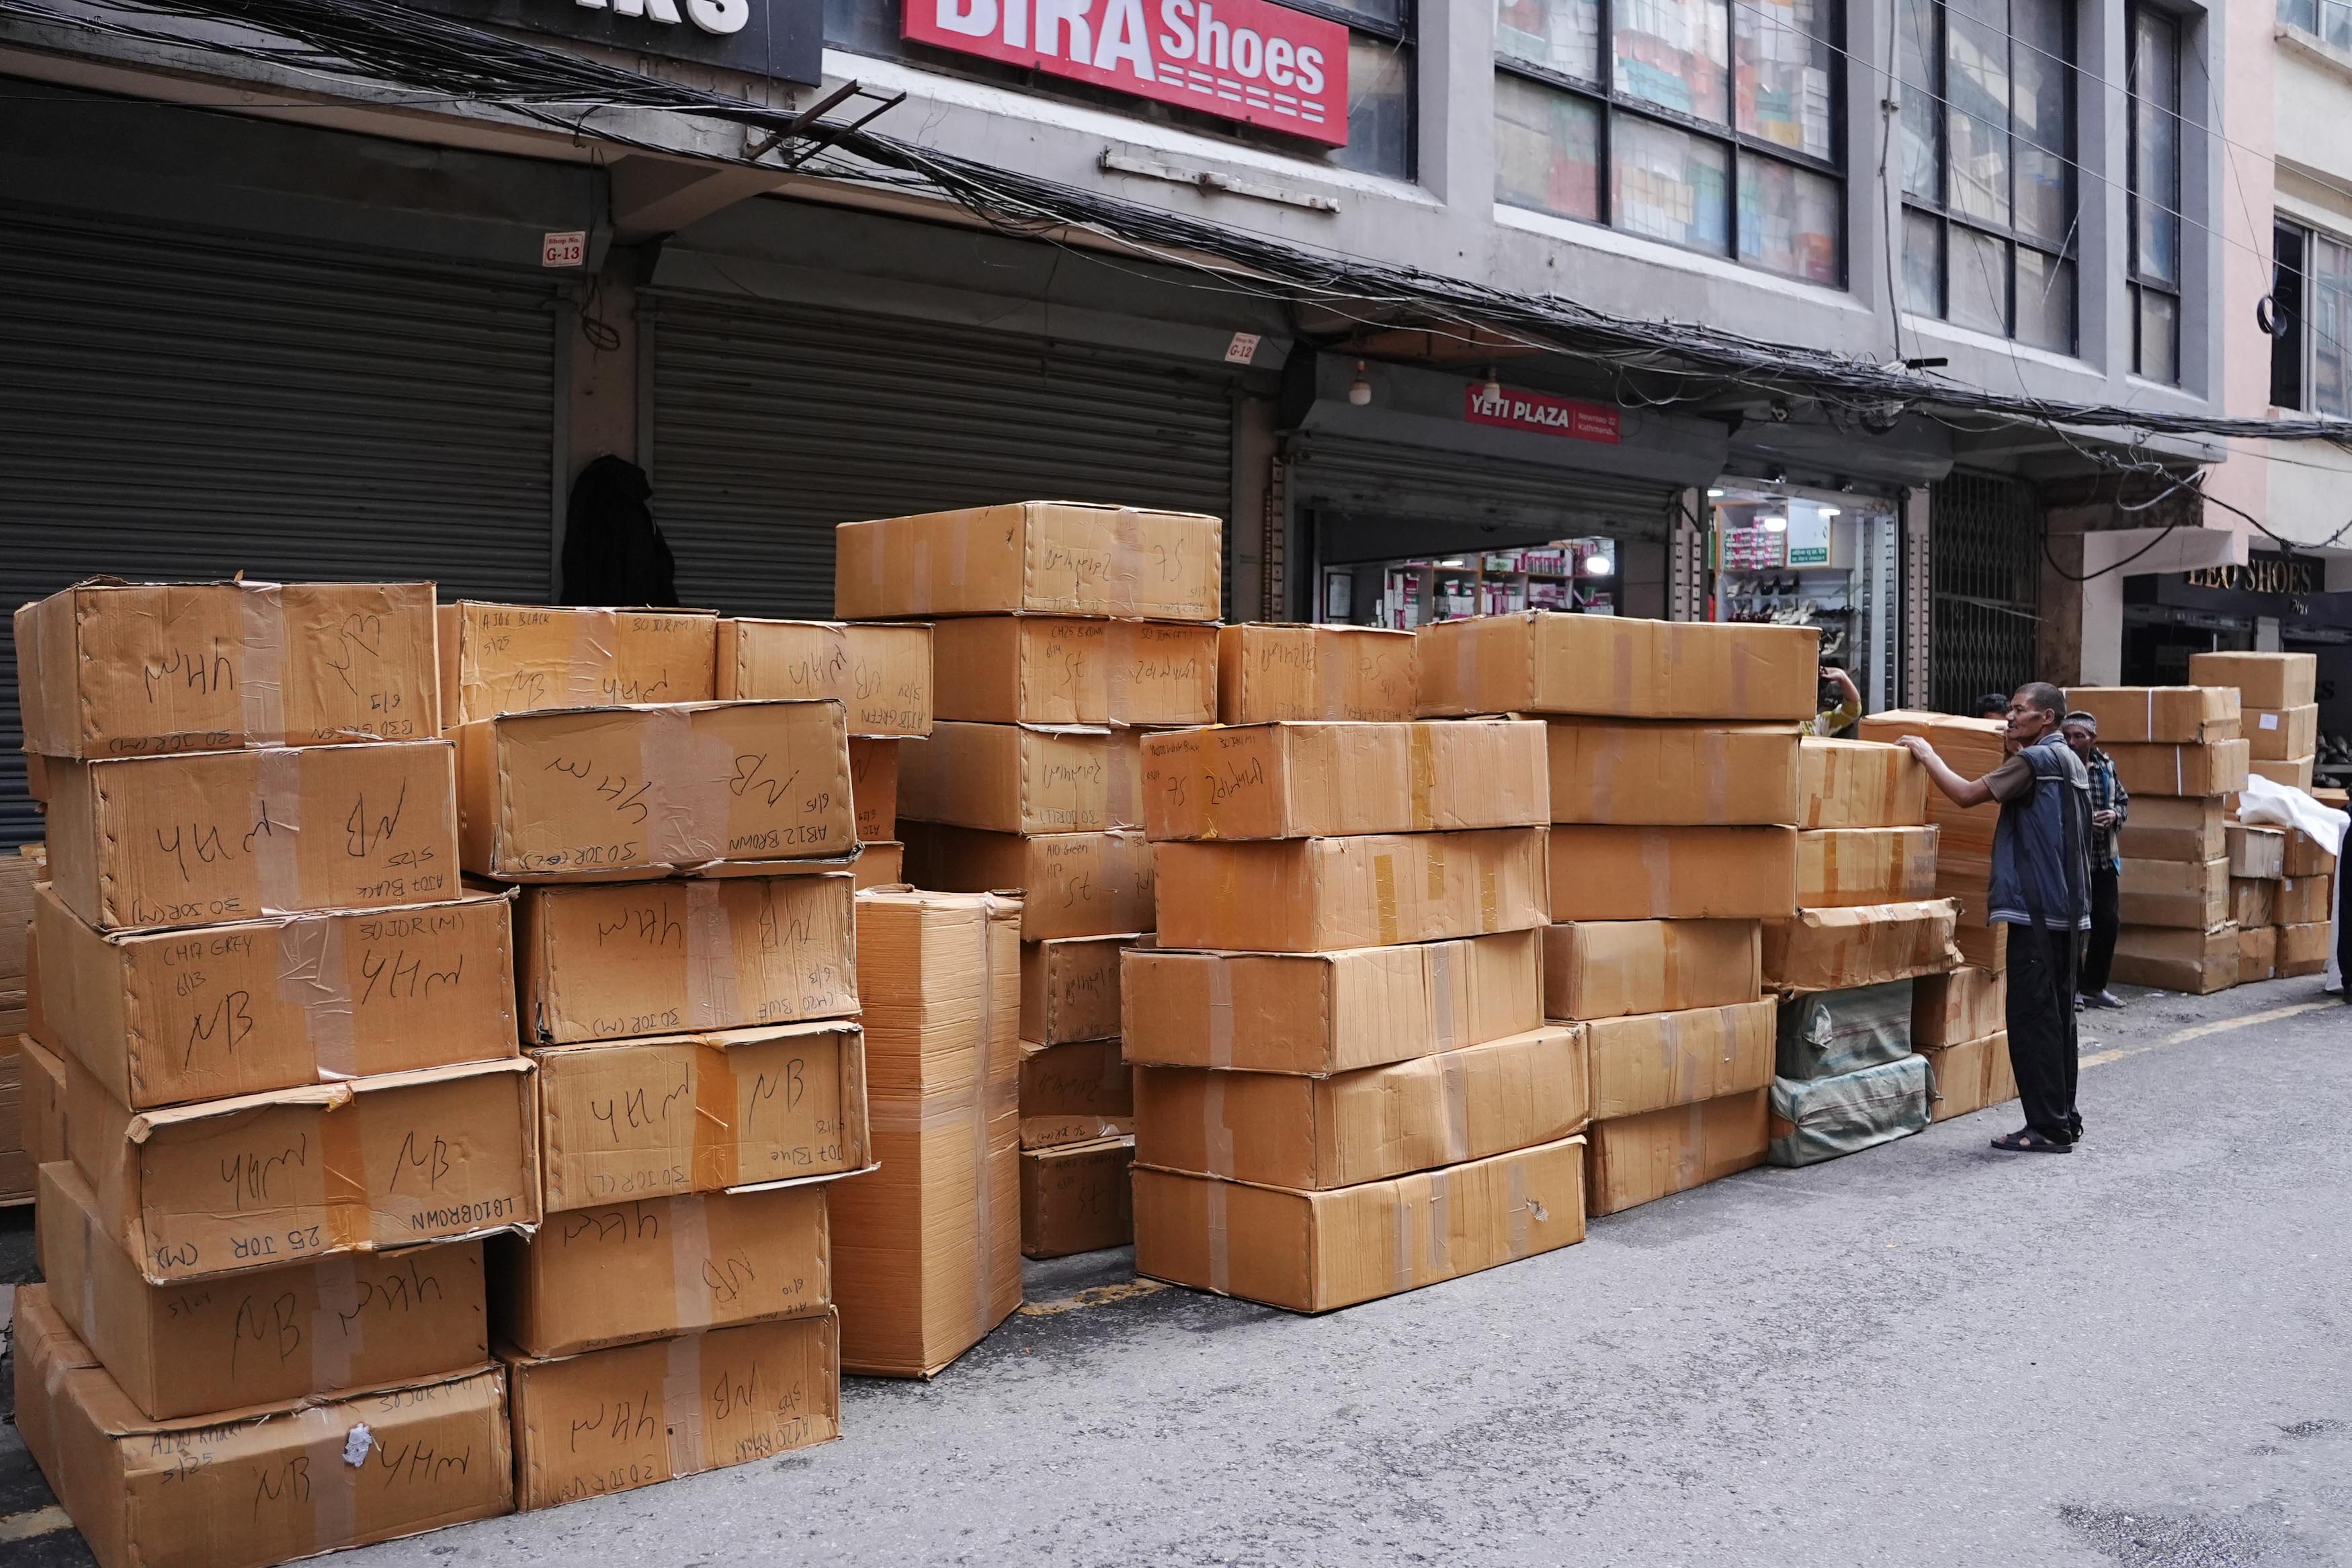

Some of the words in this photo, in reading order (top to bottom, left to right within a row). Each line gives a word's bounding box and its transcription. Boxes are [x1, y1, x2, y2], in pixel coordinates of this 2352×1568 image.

[1159, 0, 1326, 95] Shoes
[547, 247, 580, 261] G-13
[1230, 345, 1252, 358] G-12
[1472, 394, 1510, 418] YETI
[1513, 401, 1570, 428] PLAZA
[2245, 559, 2312, 596] SHOES
[206, 728, 233, 745] 30
[729, 830, 780, 851] BROWN
[209, 897, 247, 914] 30
[210, 934, 253, 957] GREY
[231, 1235, 277, 1260] JOR
[288, 1224, 321, 1248] 25
